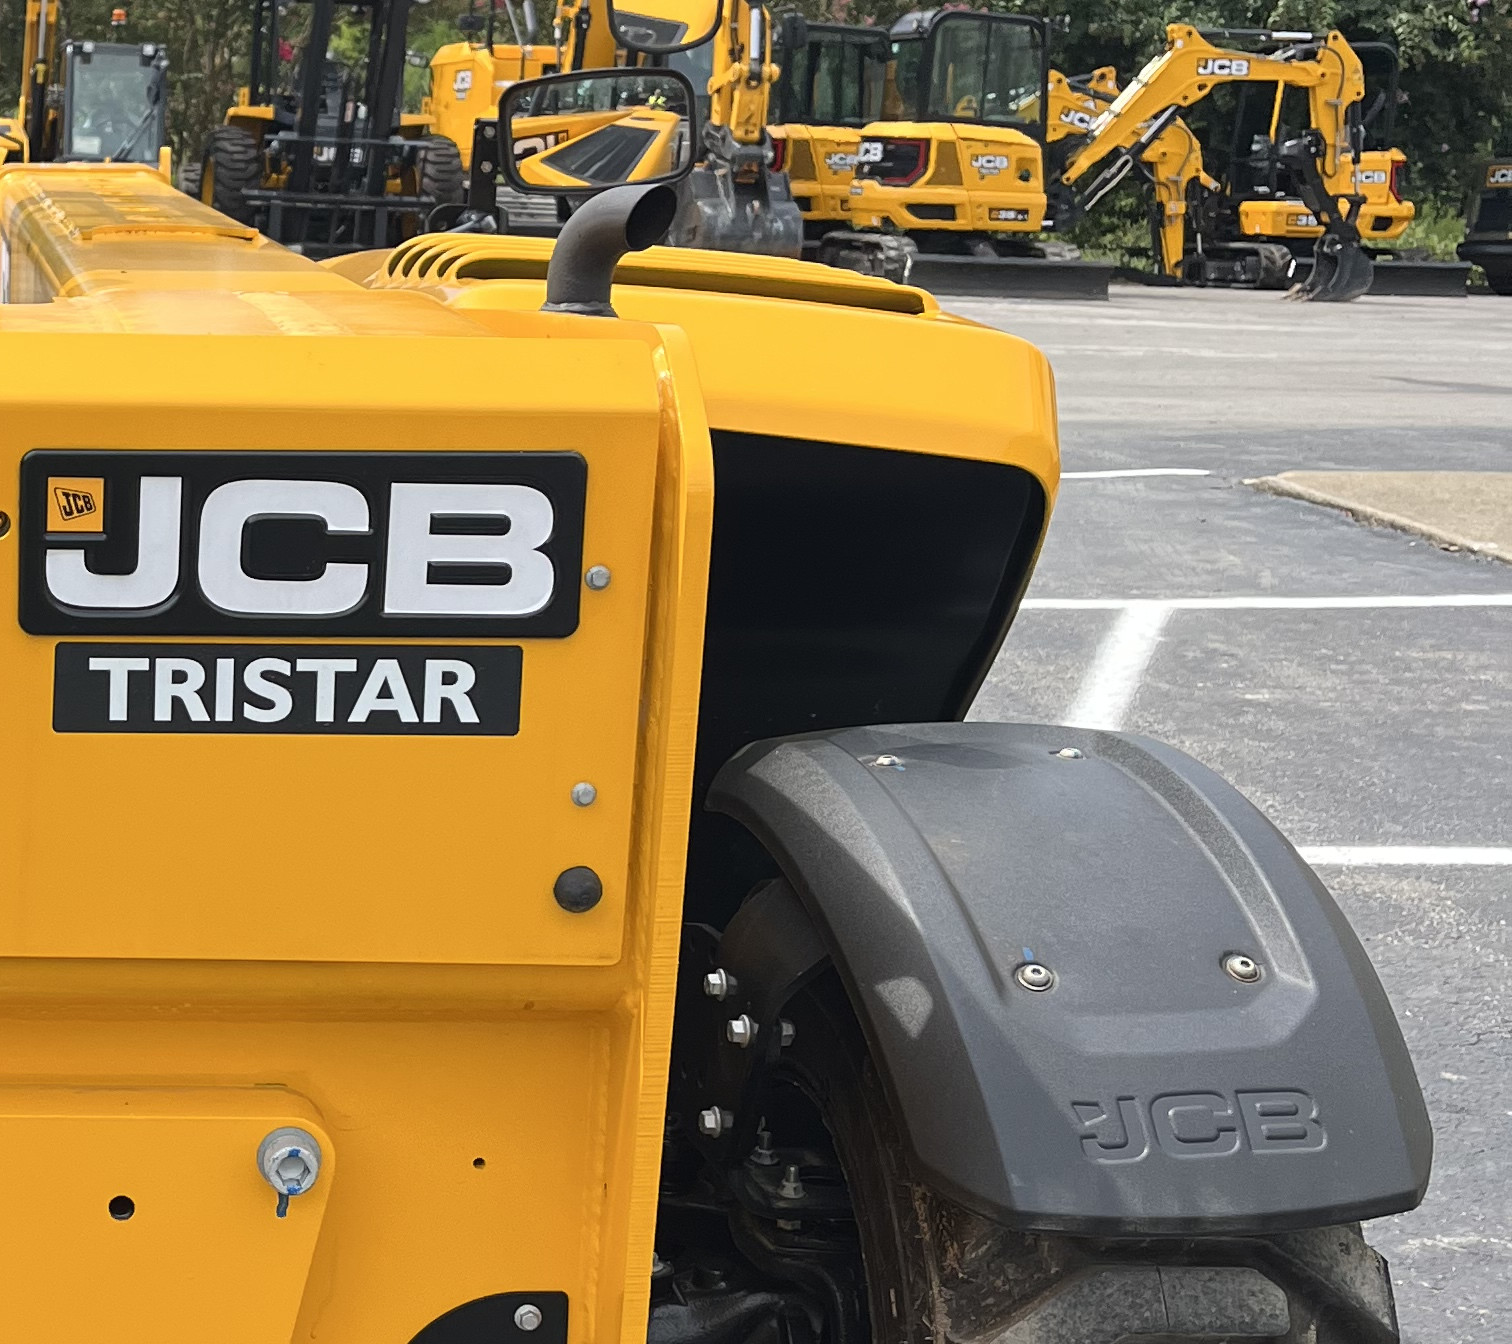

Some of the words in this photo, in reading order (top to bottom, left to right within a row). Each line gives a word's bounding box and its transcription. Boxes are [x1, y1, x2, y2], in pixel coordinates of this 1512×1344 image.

[1197, 59, 1249, 76] JCB
[971, 155, 1008, 169] JCB
[61, 491, 94, 517] JCB
[45, 475, 556, 616] JCB
[88, 657, 481, 724] TRISTAR
[1070, 1087, 1330, 1164] JCB
